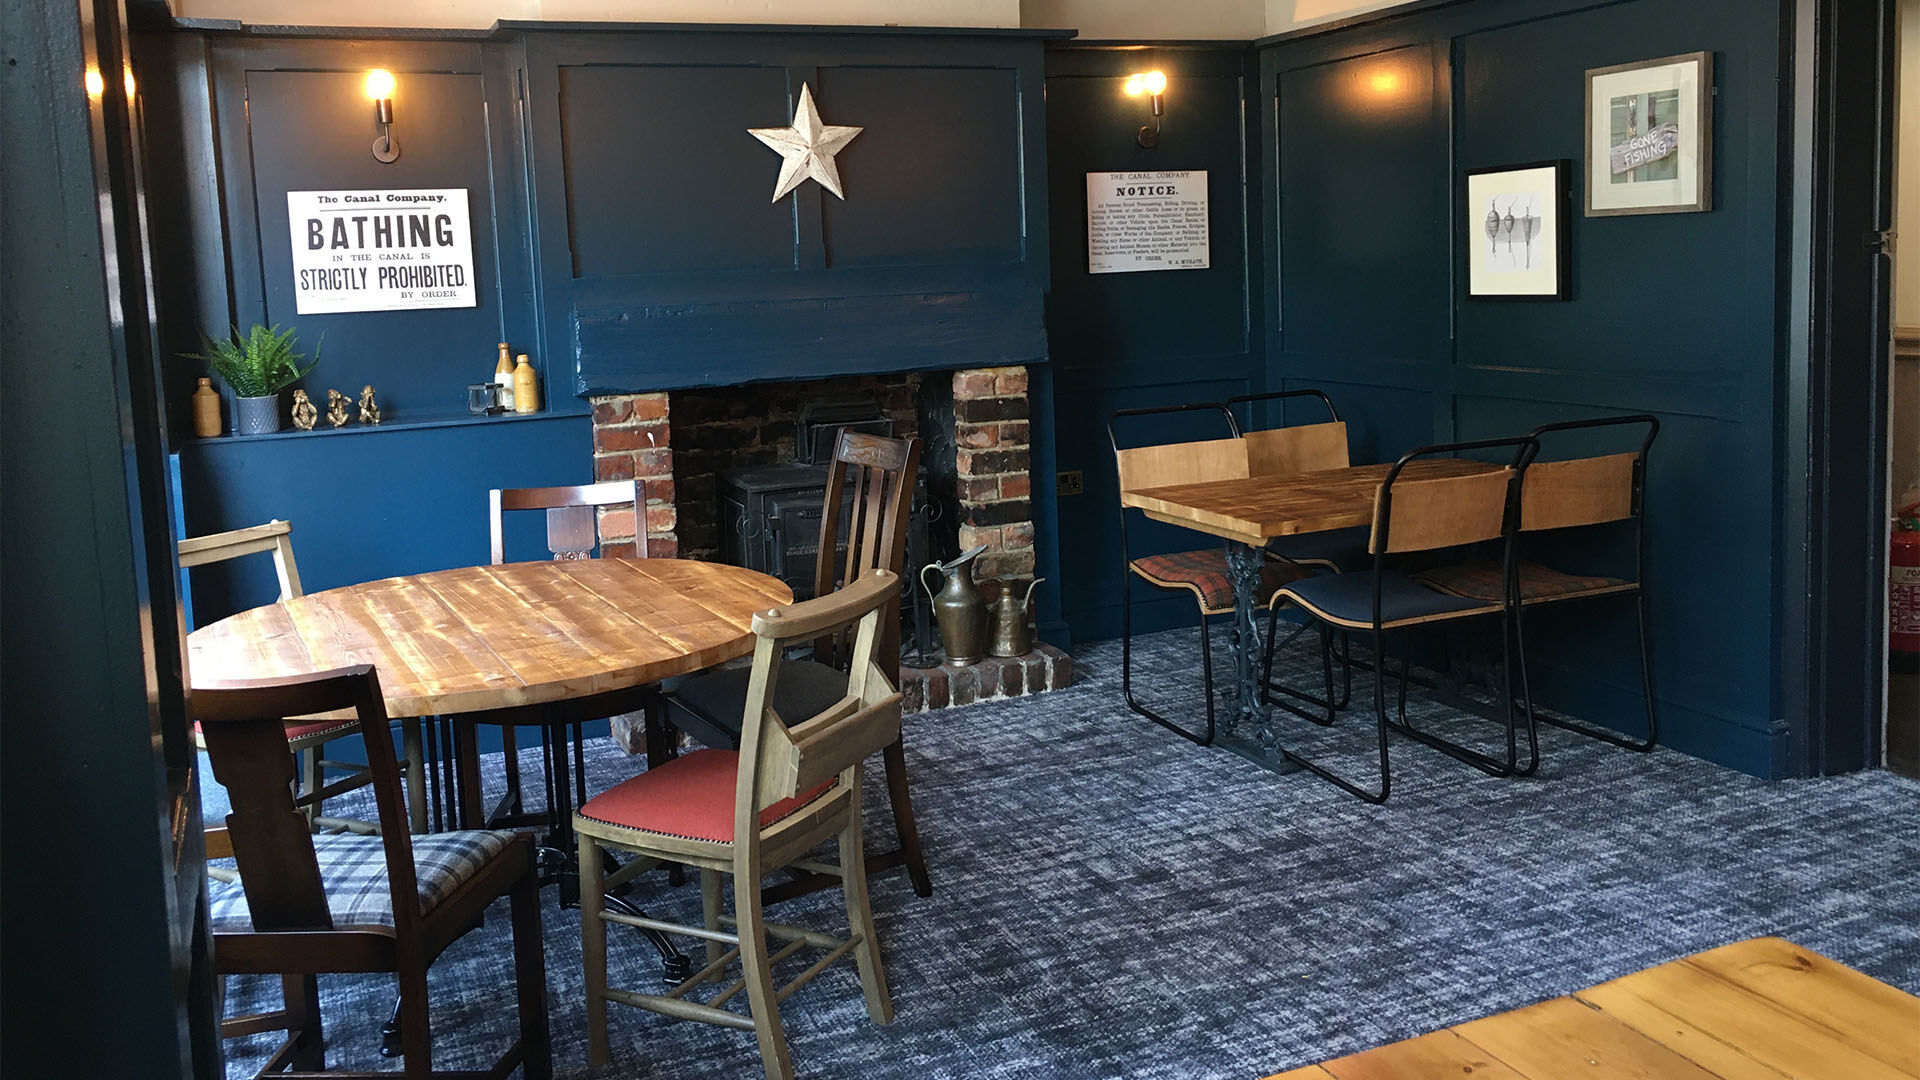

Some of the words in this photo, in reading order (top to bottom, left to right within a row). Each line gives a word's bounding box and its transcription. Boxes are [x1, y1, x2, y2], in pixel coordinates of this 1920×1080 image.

[1630, 130, 1659, 150] GONE
[1624, 142, 1667, 166] FISHING
[317, 196, 338, 204] The
[344, 194, 380, 203] Canal
[386, 194, 448, 204] Company.
[1116, 186, 1179, 196] NOTICE.
[307, 214, 454, 250] BATHING
[301, 267, 367, 290] STRICTLY
[379, 265, 467, 289] PROHIBITED.
[422, 290, 457, 298] ORDER
